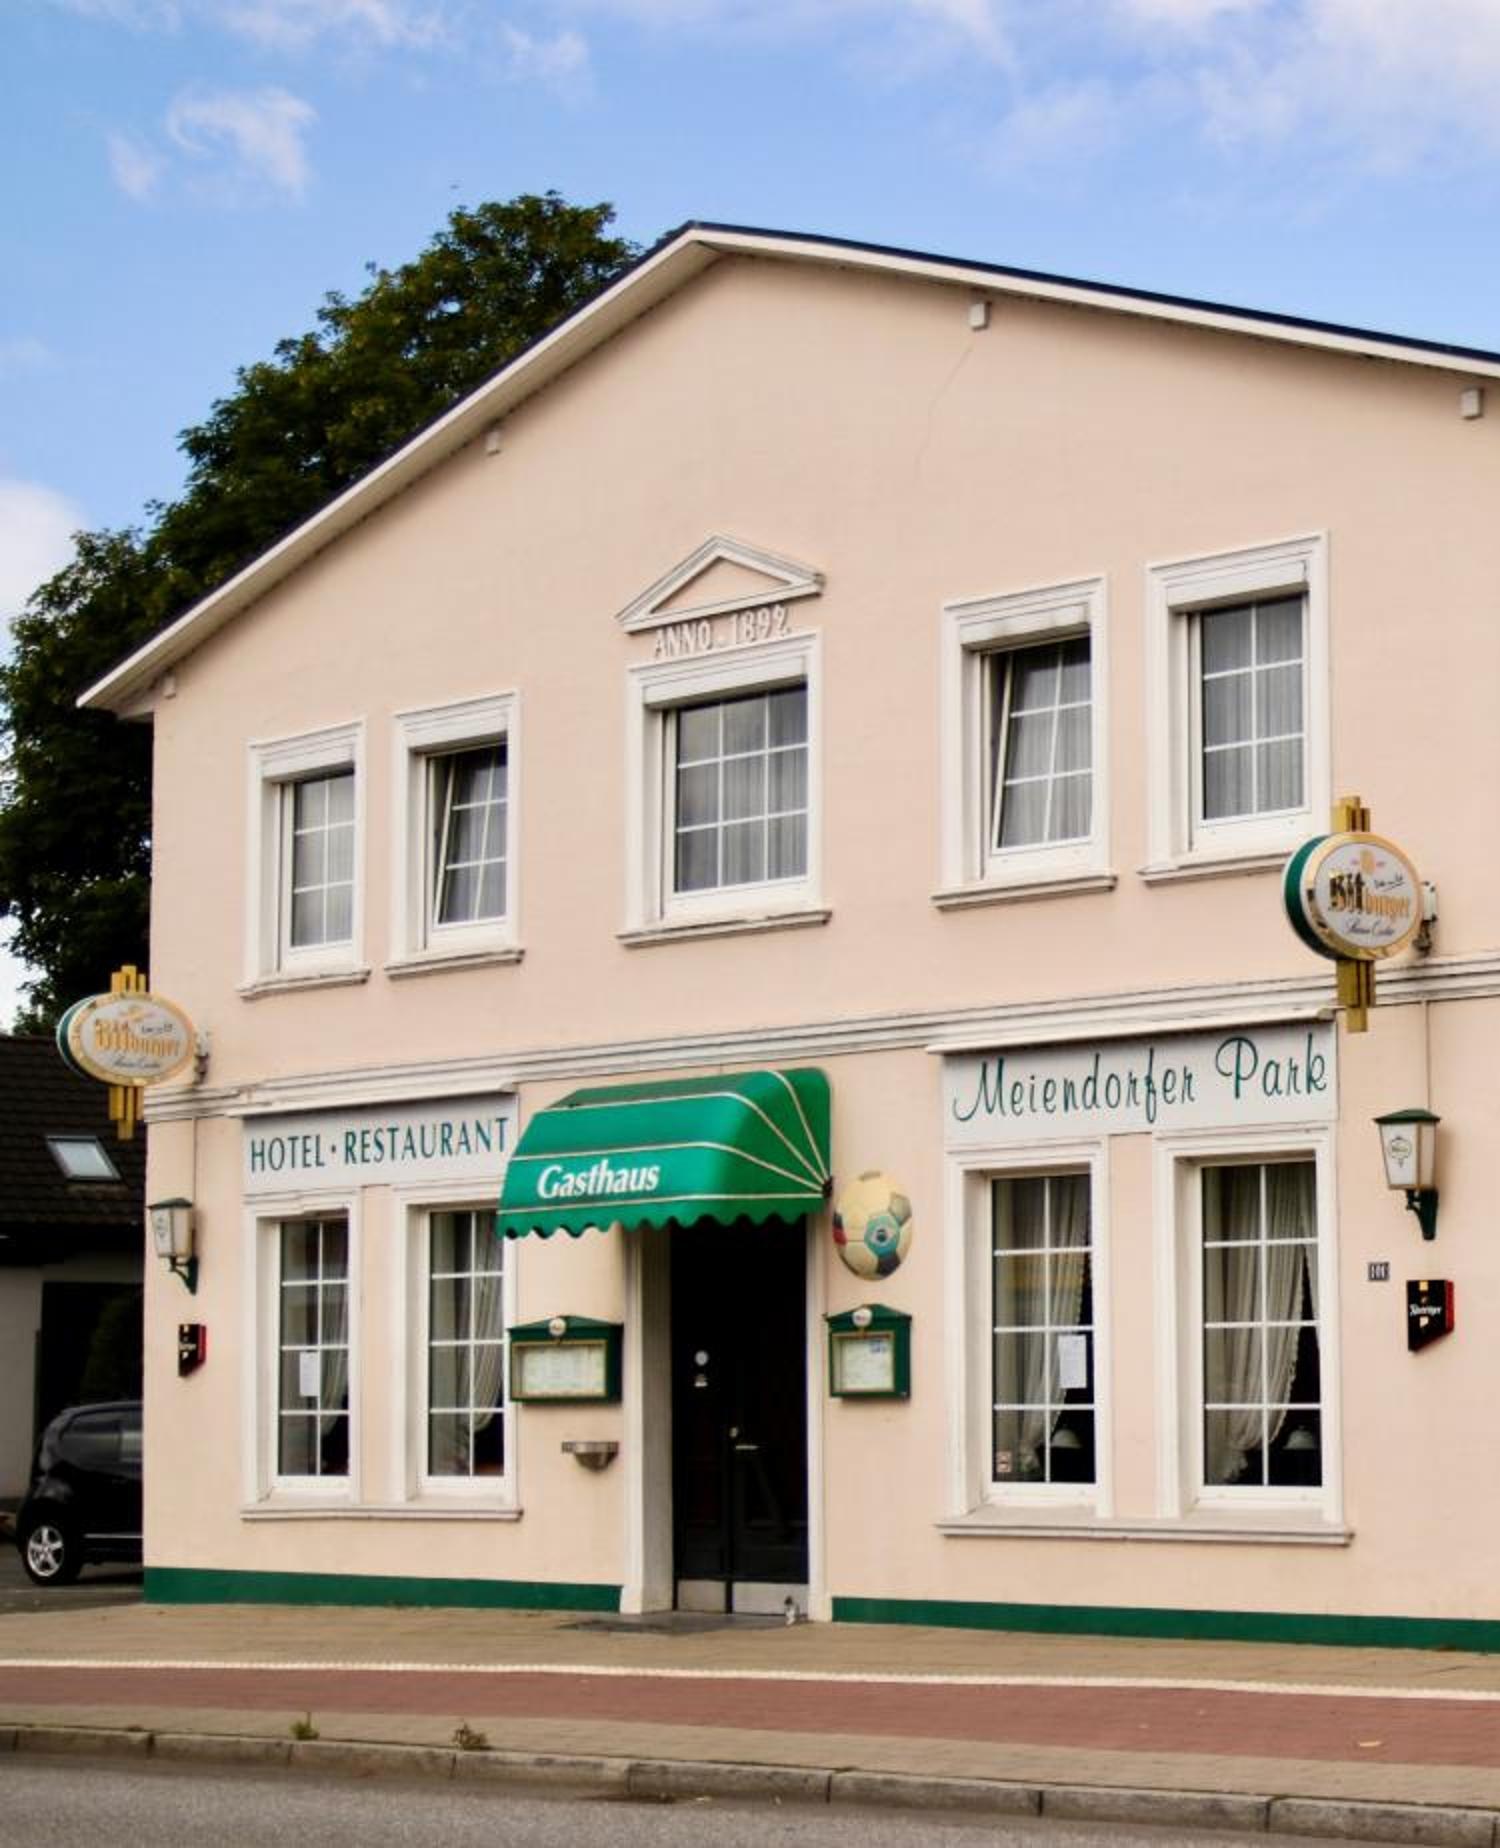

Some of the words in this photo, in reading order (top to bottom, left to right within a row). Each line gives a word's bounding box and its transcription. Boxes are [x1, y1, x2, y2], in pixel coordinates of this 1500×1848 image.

[655, 620, 713, 658] ANNO
[730, 604, 791, 645] 1892
[952, 1046, 1196, 1124] Meiendorfer
[1215, 1032, 1328, 1100] Park
[250, 1134, 325, 1173] HOTEL
[344, 1117, 509, 1165] RESTAURANT
[537, 1159, 660, 1199] Gasthaus
